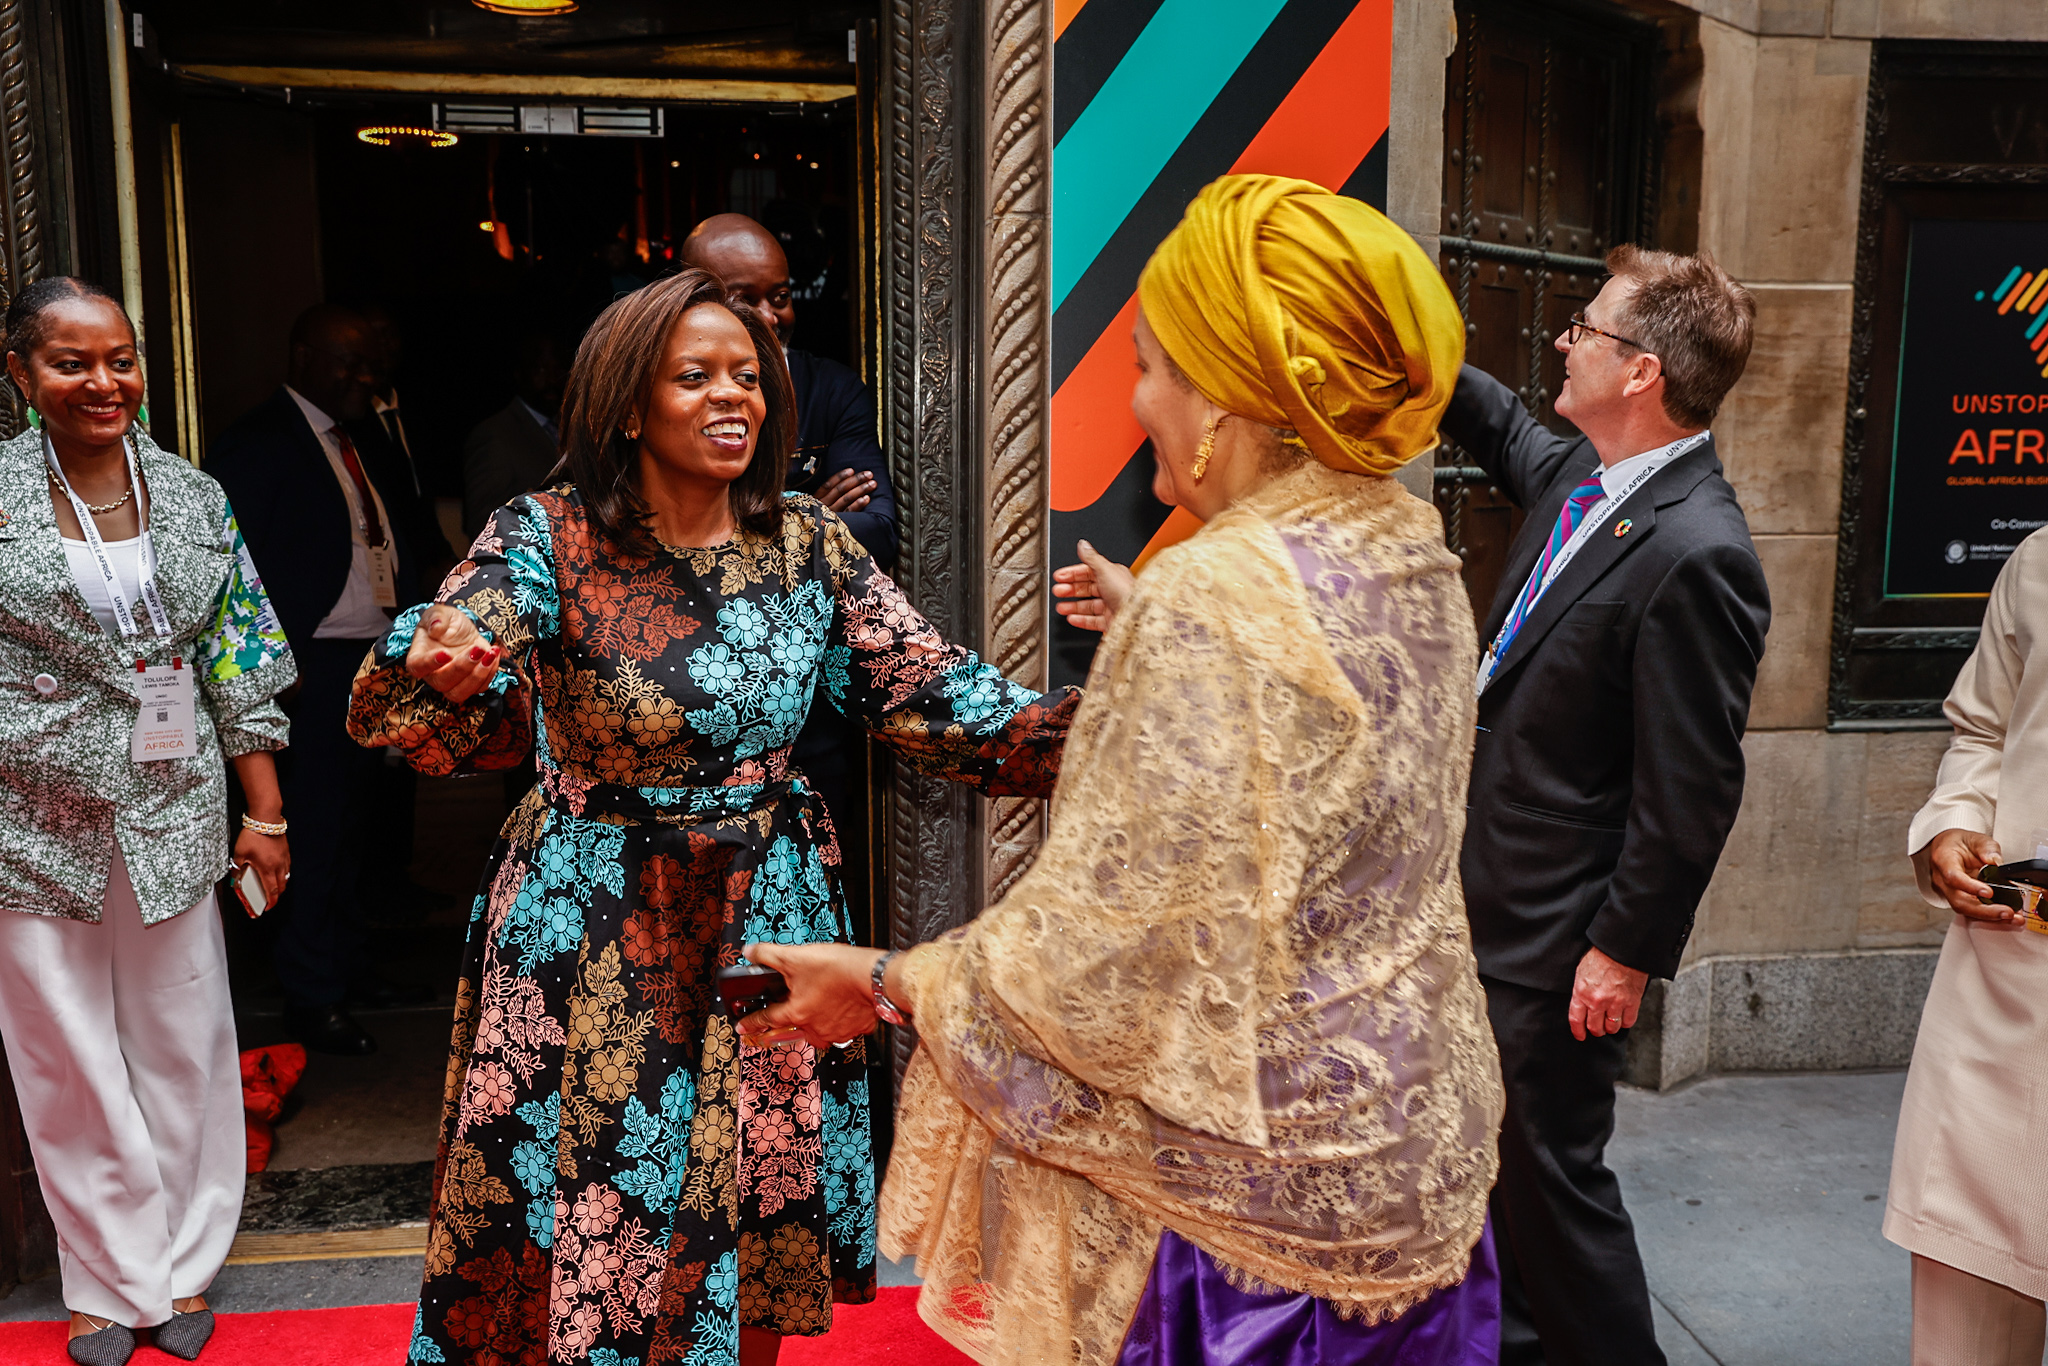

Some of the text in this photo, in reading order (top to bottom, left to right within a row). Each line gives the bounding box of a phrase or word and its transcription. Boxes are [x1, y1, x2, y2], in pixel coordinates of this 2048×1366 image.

[1952, 394, 2048, 414] UNSTOP
[1948, 428, 2048, 465] AFR
[1946, 475, 1985, 486] GLOBAL
[1986, 475, 2024, 486] AFRICA
[1582, 465, 1655, 538] UNSTOPPABLE AFRICA
[75, 501, 114, 582] UNSTOPPABLE AFRICA
[144, 579, 159, 608] AFRICA
[144, 675, 177, 683] TOLULOPE
[143, 733, 184, 741] UNSTOPPABLE
[144, 740, 184, 751] AFRICA
